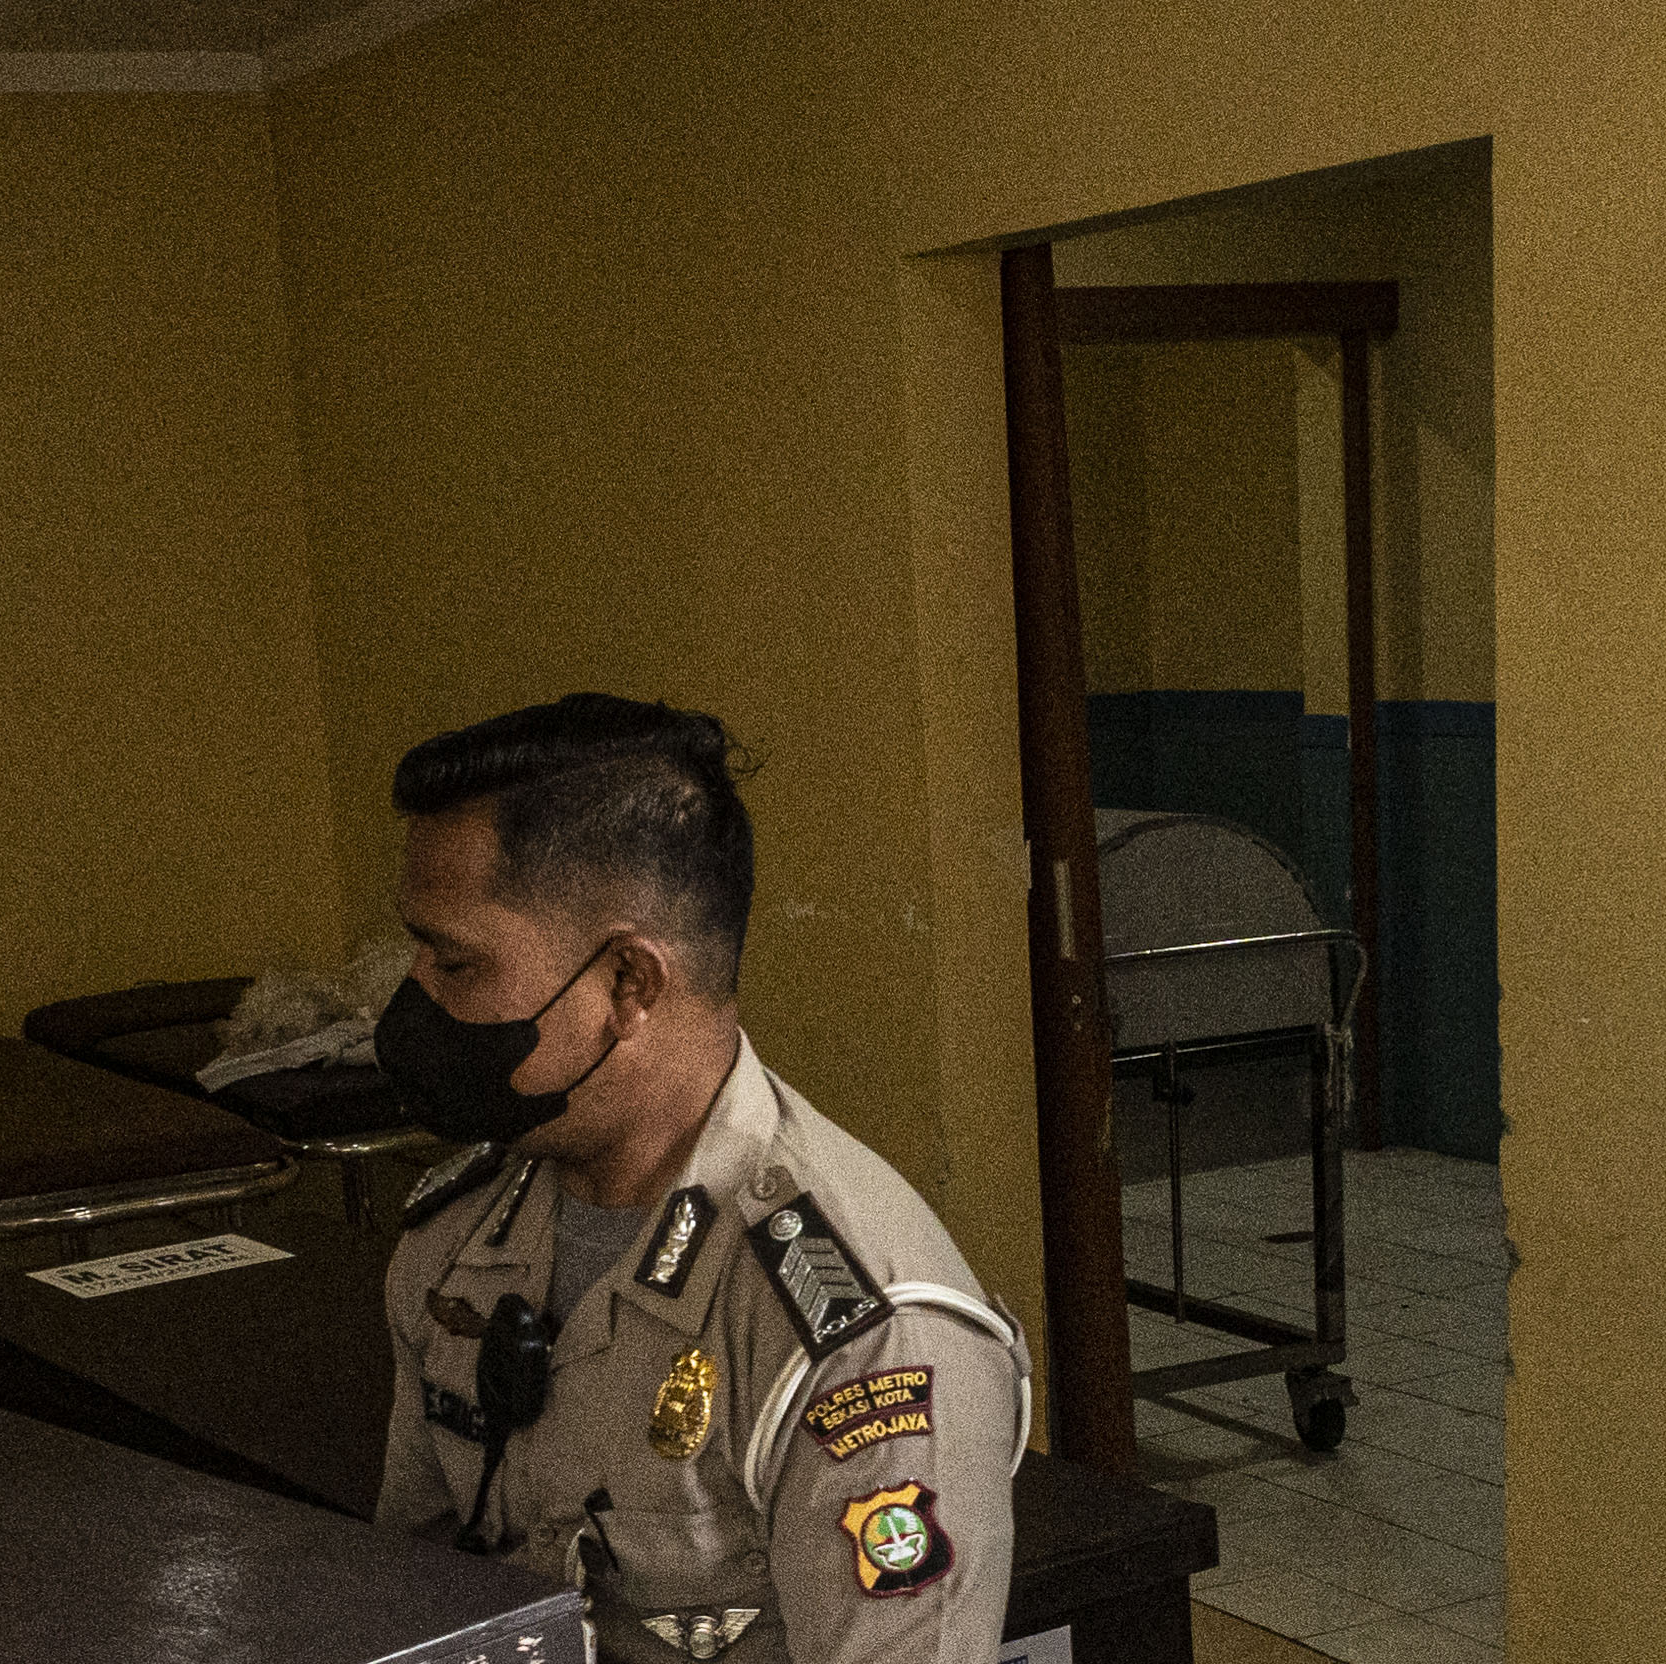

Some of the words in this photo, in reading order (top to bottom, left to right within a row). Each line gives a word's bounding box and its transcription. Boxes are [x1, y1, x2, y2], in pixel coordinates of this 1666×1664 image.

[60, 1269, 116, 1287] M.
[118, 1243, 229, 1275] SIRAT
[806, 1383, 865, 1425] POLRES
[869, 1371, 928, 1393] METRO
[822, 1401, 871, 1430] BEKASI
[874, 1388, 915, 1408] KOTA
